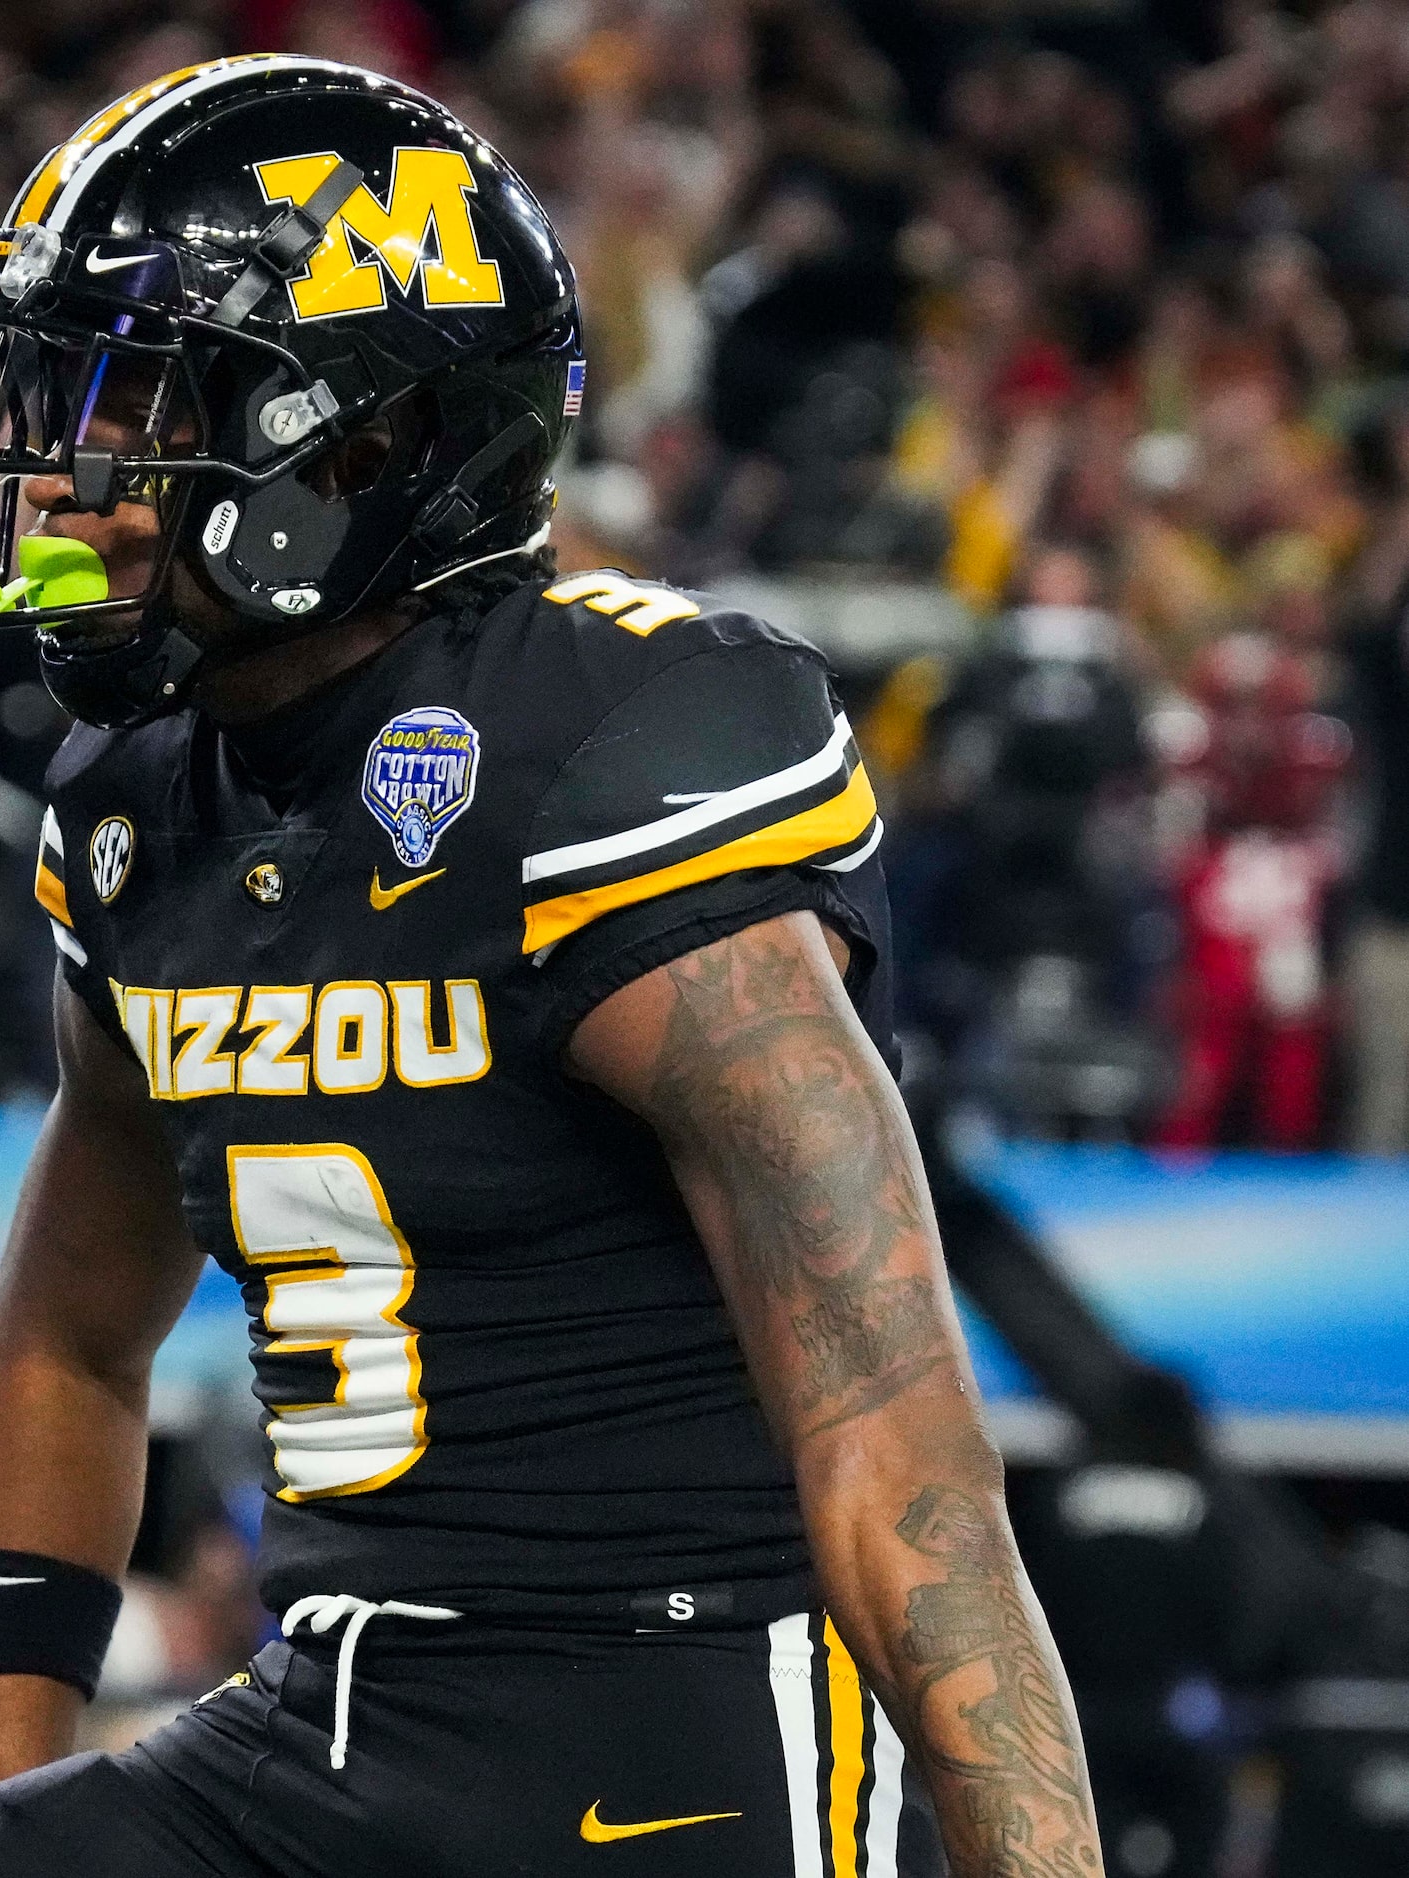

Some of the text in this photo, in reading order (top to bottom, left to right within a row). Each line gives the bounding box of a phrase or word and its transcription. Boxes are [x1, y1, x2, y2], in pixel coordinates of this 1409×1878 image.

[252, 146, 506, 324] M
[210, 505, 232, 550] schutt
[374, 751, 467, 802] COTTON
[387, 780, 447, 813] BOWL
[92, 821, 131, 899] SEC
[226, 1142, 432, 1503] 3
[666, 1592, 696, 1621] S
